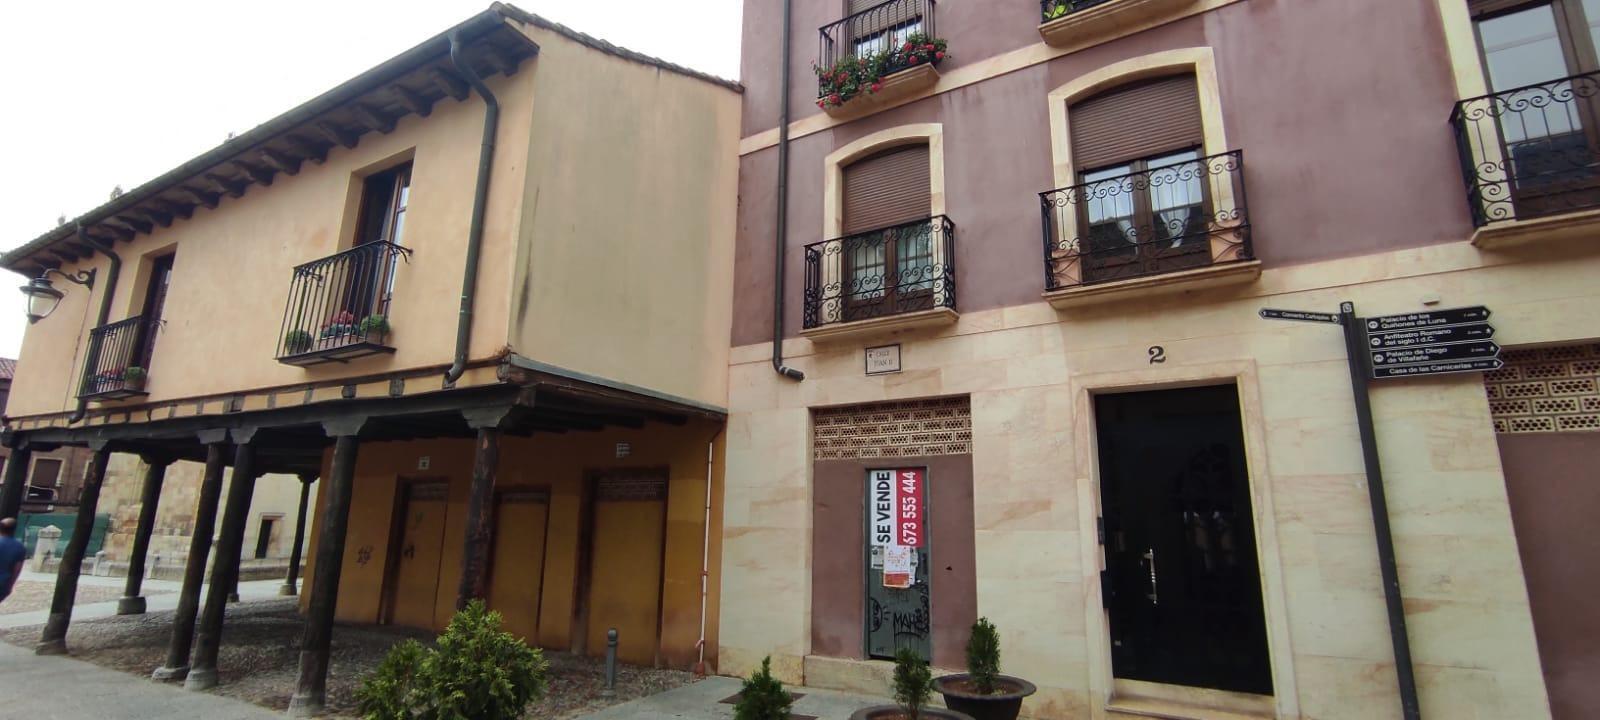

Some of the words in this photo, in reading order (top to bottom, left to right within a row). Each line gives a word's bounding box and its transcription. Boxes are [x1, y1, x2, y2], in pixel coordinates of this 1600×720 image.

[1384, 332, 1419, 340] Anfiteatro
[1420, 329, 1452, 337] Romano
[1397, 337, 1415, 346] siglo
[1149, 345, 1166, 364] 2
[1386, 350, 1413, 358] Palacio
[1425, 347, 1448, 355] Diego
[902, 471, 916, 494] 444
[876, 471, 891, 522] VENDE
[902, 496, 917, 519] 555
[876, 524, 891, 544] SE
[902, 522, 917, 545] 673
